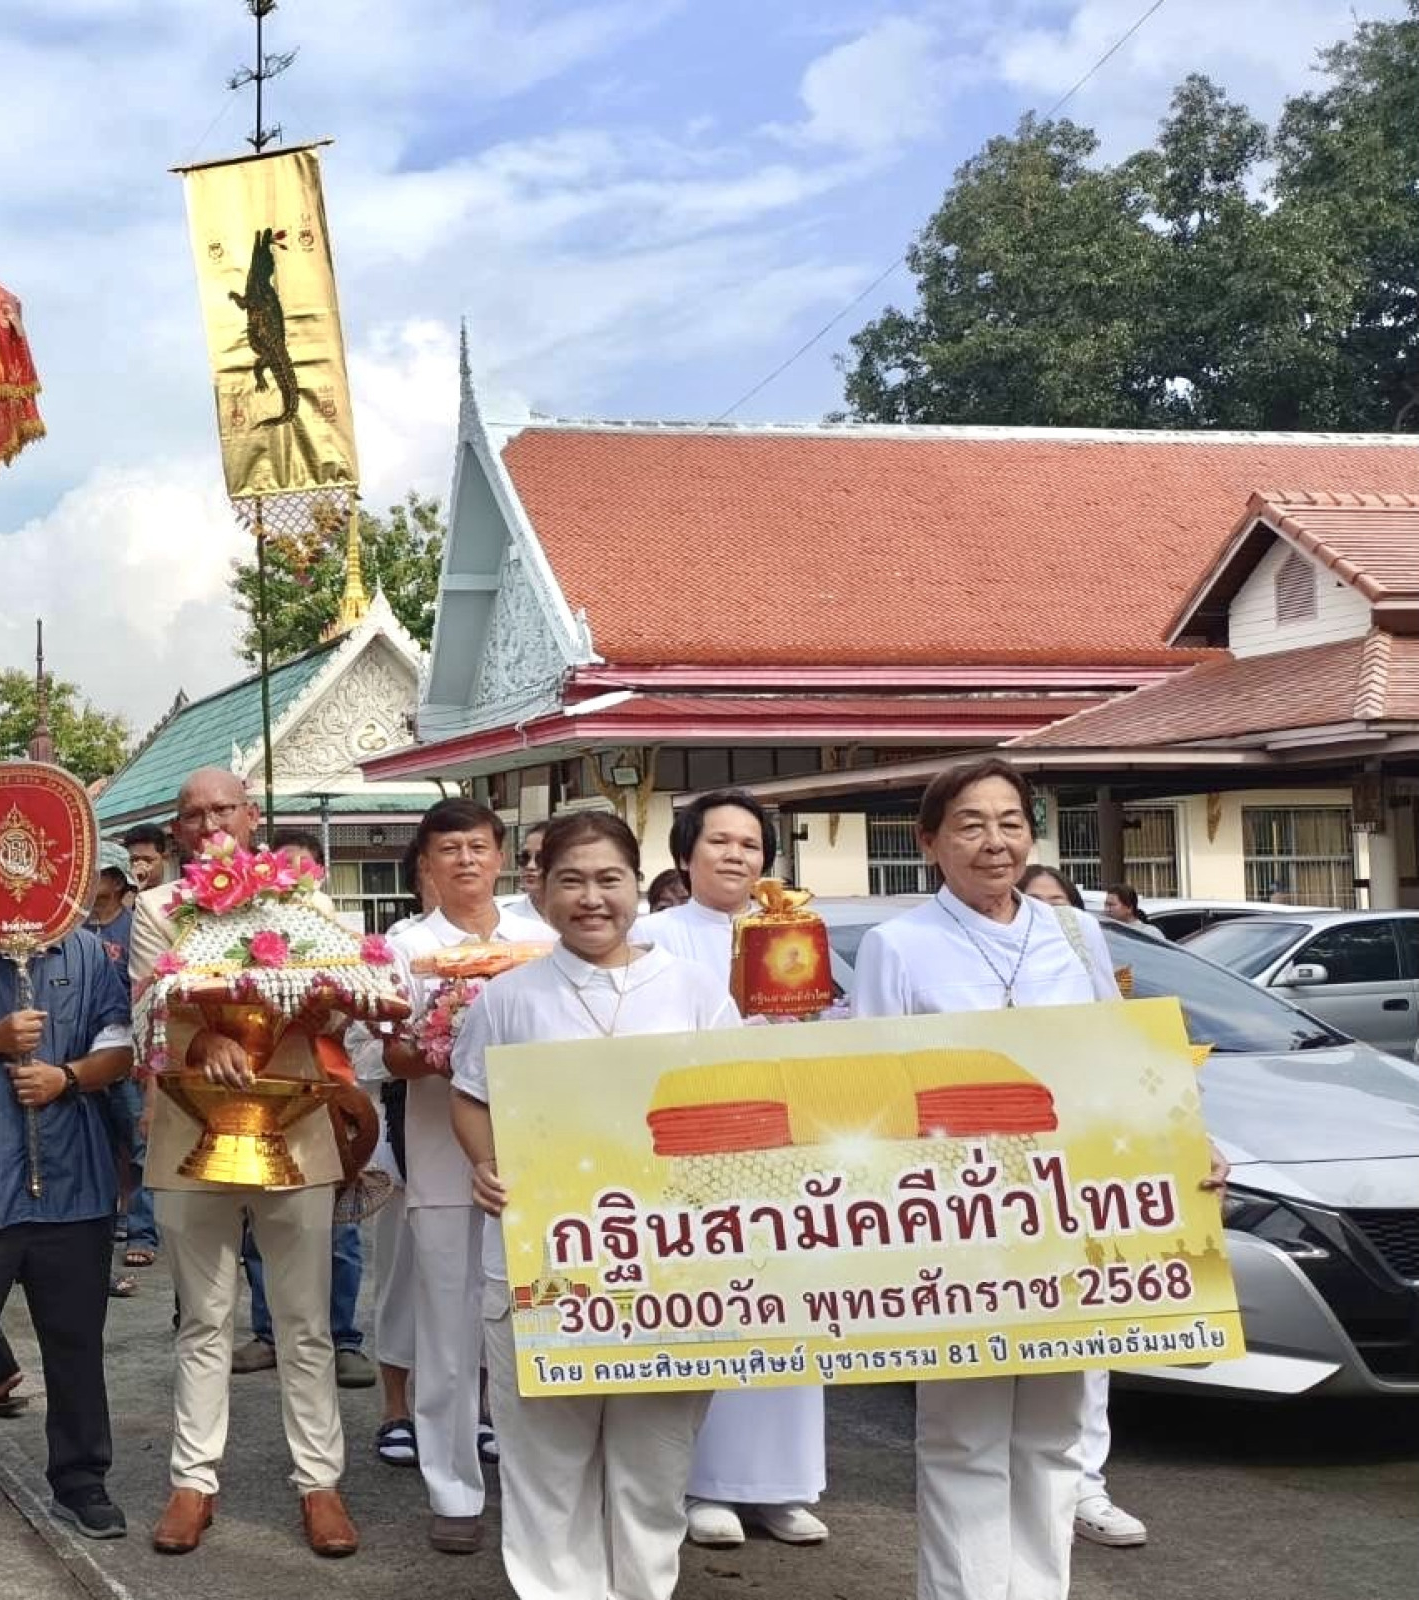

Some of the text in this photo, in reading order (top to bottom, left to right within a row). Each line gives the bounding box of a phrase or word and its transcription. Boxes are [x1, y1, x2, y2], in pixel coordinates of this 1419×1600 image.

[551, 1147, 1176, 1284] กฐินสามัคคีทั่วไทย
[558, 1261, 1192, 1339] 30,000วัด พุทธศักราช 2568
[534, 1321, 1225, 1384] โดย คณะศิษยานุศิษย์ บูชาธรรม 81 ปี หลวงพ่อธัมมชโย
